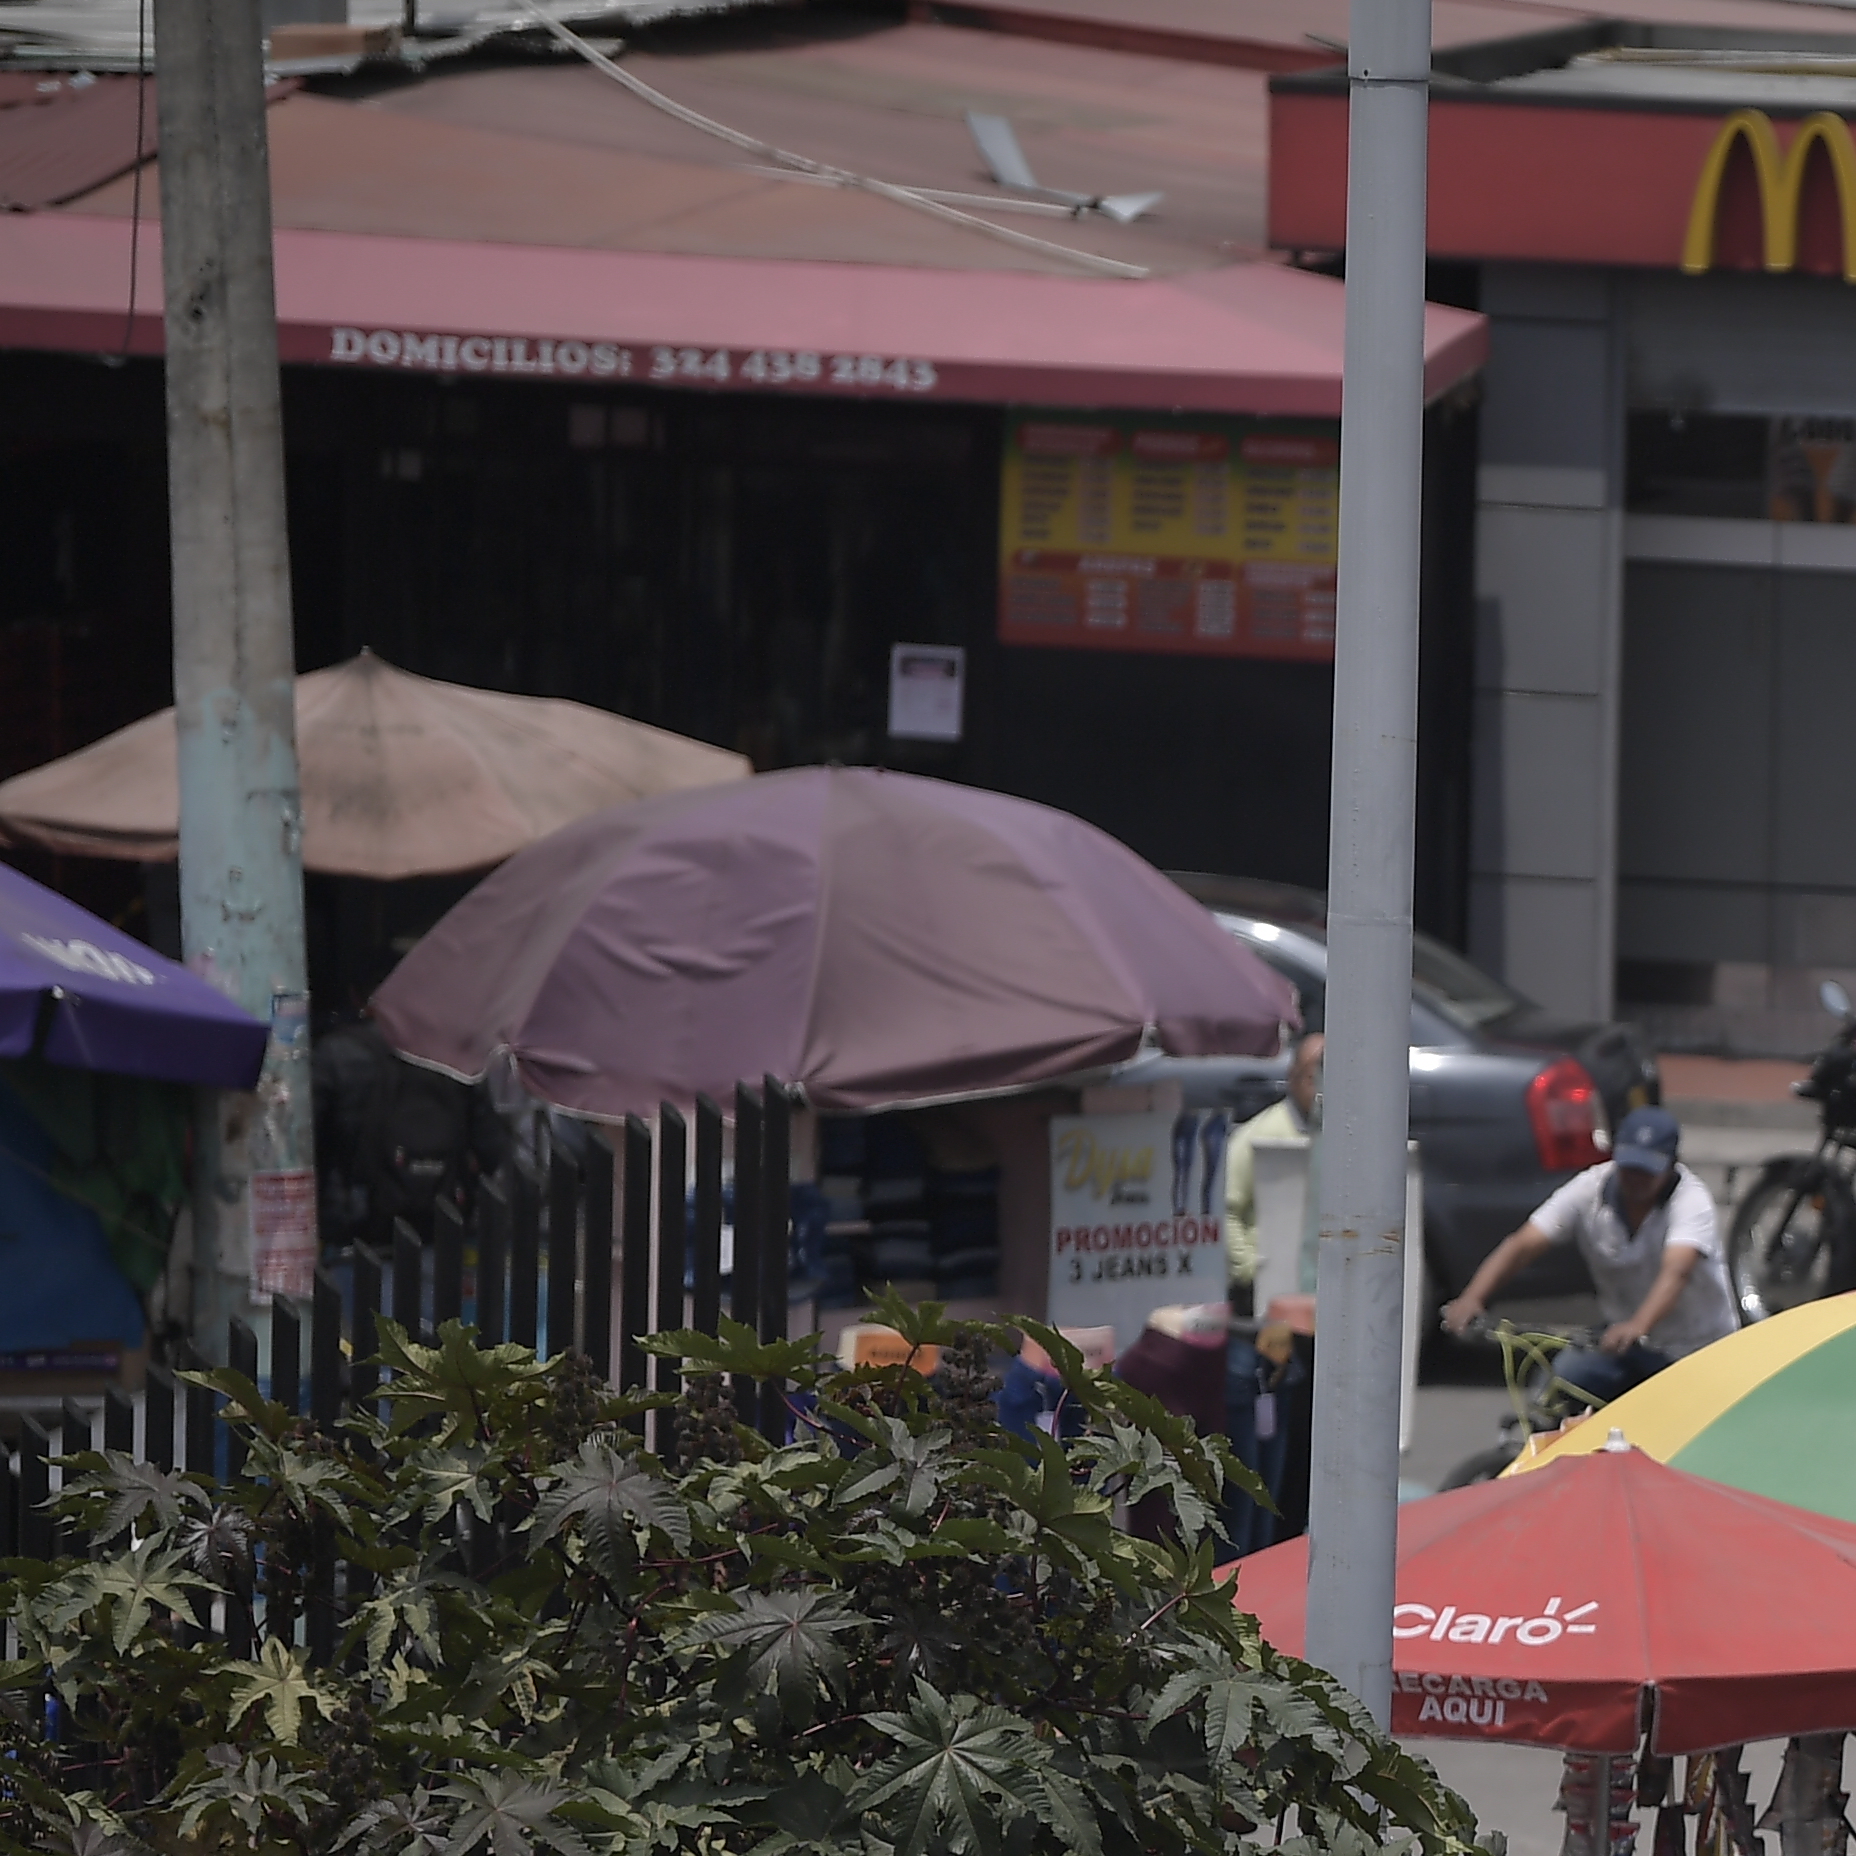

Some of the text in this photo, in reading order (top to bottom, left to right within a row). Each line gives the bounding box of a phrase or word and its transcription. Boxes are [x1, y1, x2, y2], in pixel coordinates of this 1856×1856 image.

[329, 326, 632, 377] DOMICILIOS:
[1069, 1251, 1193, 1283] 3 JEANS X
[1392, 1598, 1577, 1647] Claro
[1418, 1696, 1505, 1727] AQUI
